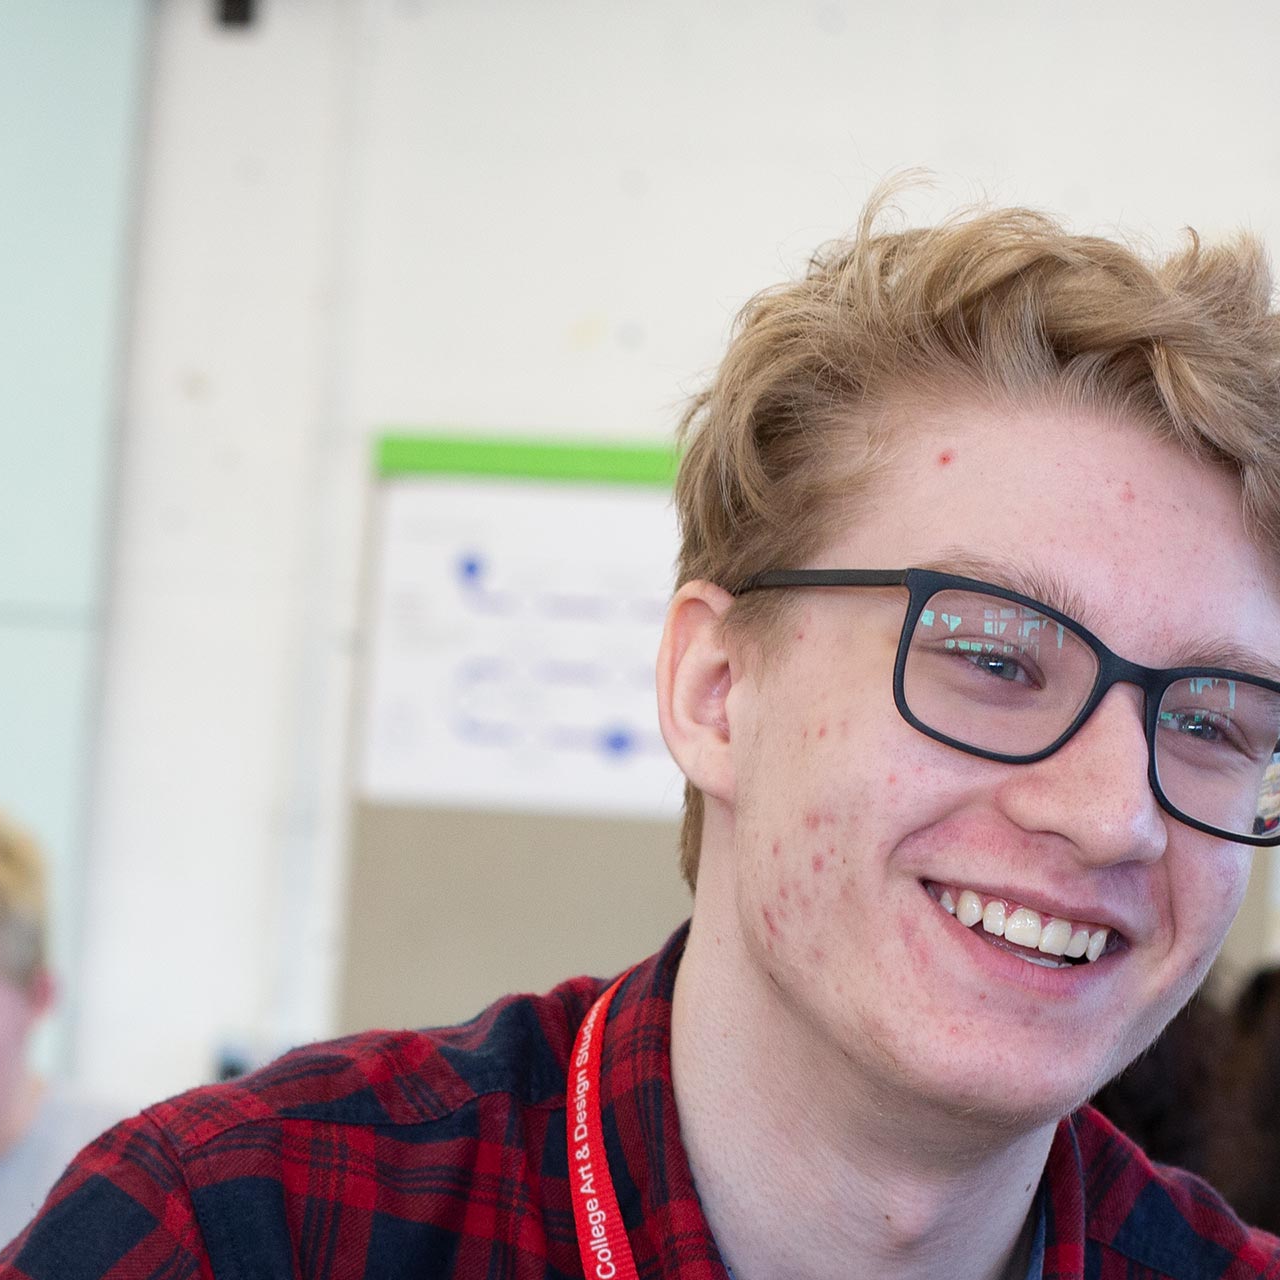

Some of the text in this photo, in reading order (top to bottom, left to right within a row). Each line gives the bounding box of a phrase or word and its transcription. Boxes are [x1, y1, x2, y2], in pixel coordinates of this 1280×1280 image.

[573, 1071, 589, 1142] Design
[575, 1144, 591, 1161] &
[578, 1163, 597, 1194] Art
[586, 1198, 616, 1279] College
